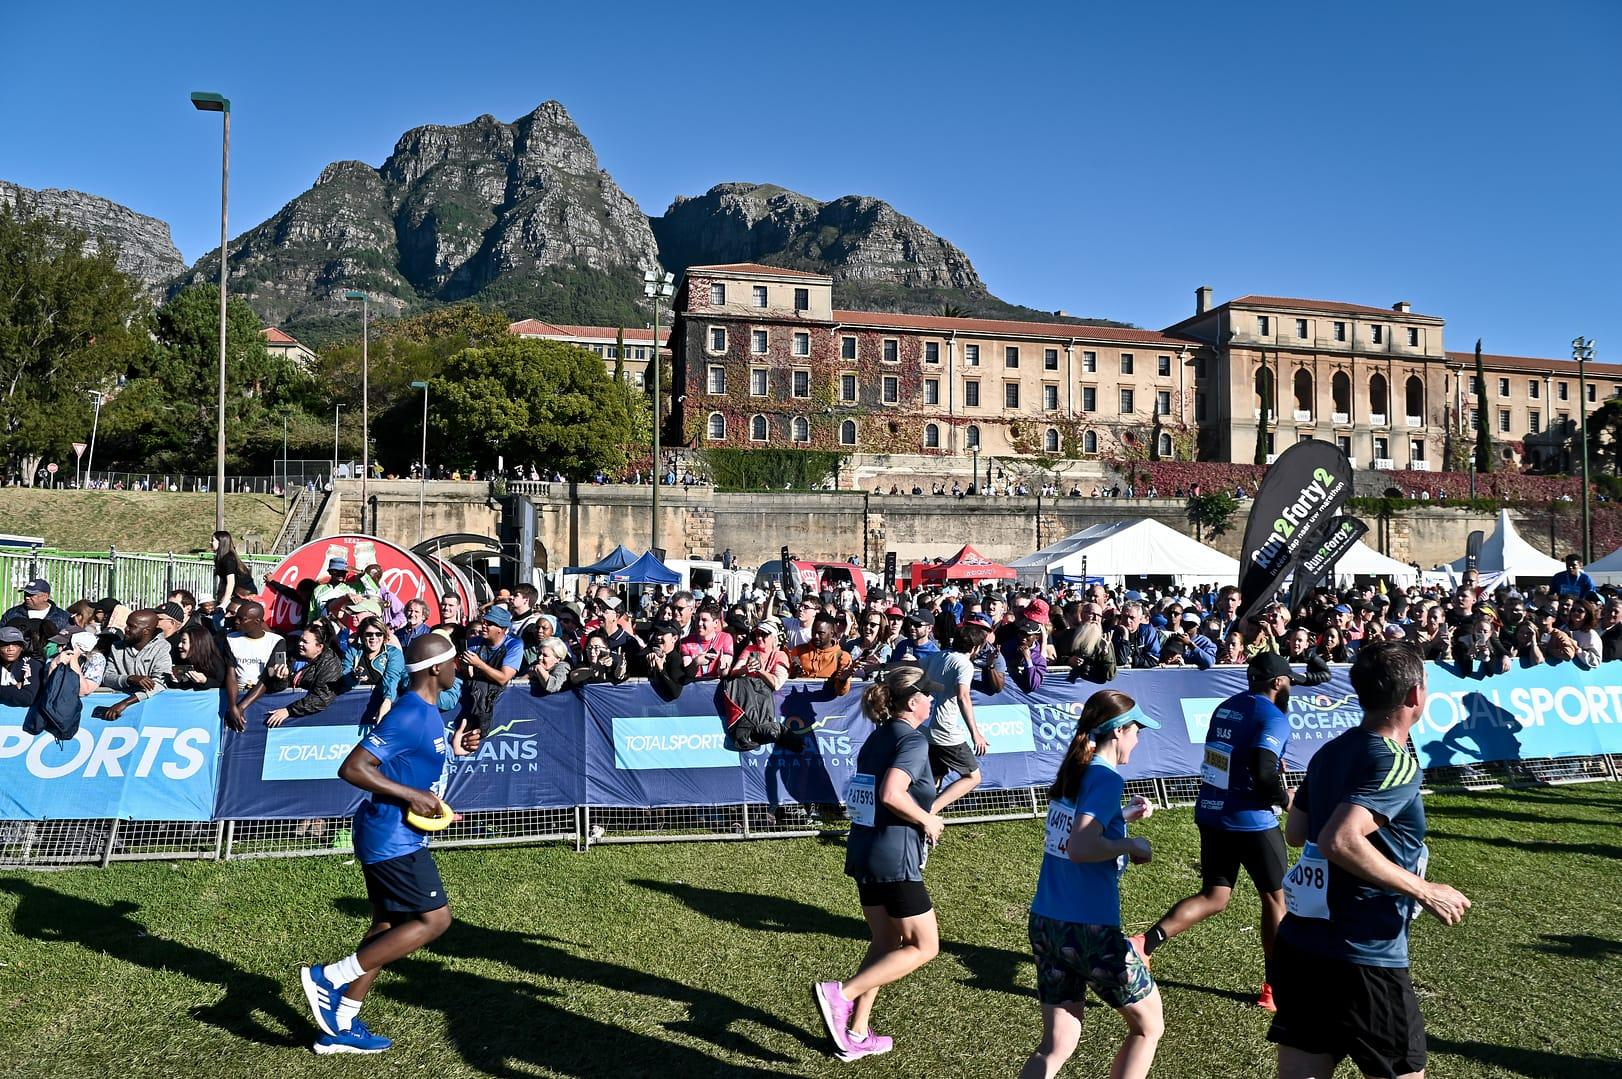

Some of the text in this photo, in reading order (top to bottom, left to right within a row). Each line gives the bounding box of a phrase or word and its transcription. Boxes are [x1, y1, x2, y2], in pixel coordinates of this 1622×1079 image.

[1319, 481, 1345, 512] marathon
[1288, 711, 1364, 729] OCEAN
[625, 733, 726, 751] TOTALSPORTS
[279, 744, 352, 761] TOTALSP
